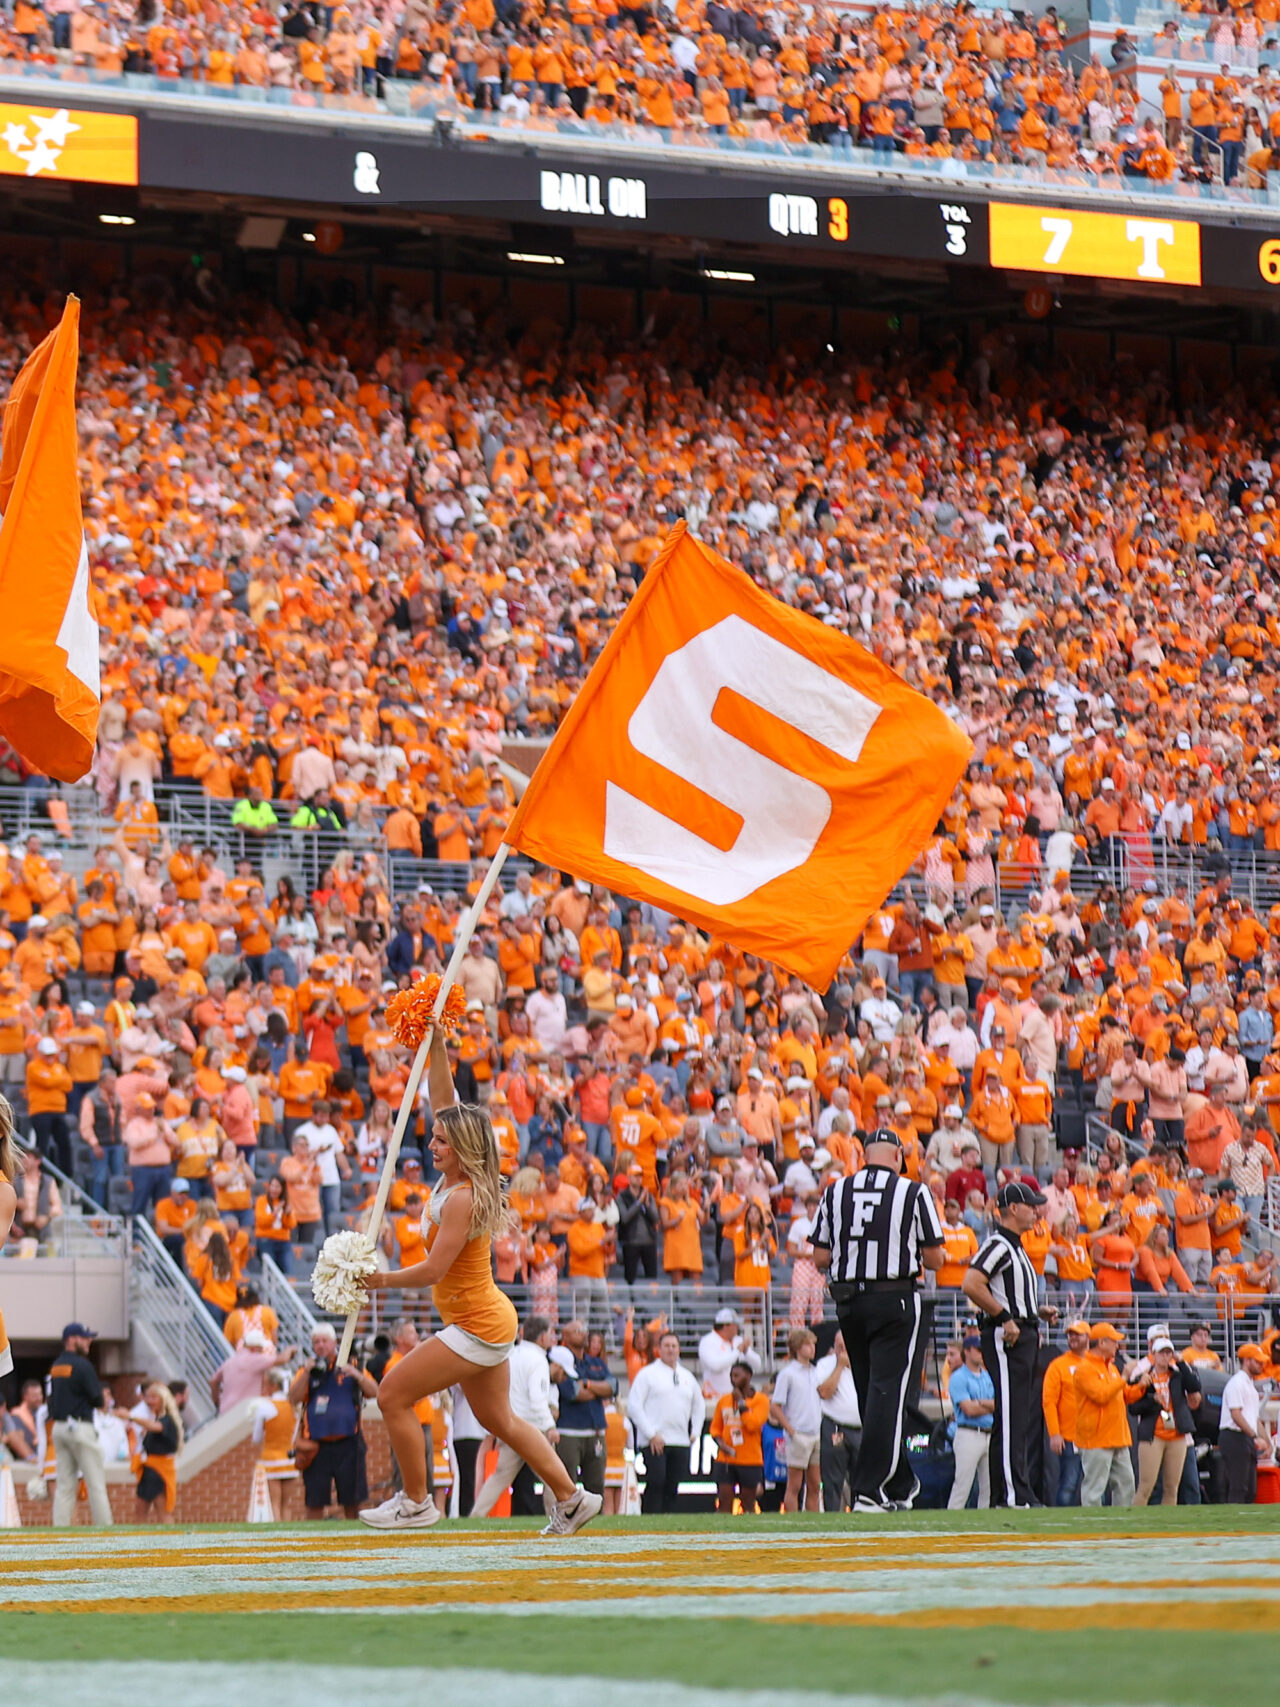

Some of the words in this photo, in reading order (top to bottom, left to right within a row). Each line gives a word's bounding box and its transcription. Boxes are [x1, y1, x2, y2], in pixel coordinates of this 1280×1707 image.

[353, 151, 381, 194] &
[540, 170, 605, 215] BALL
[608, 177, 647, 219] ON
[769, 193, 818, 236] QTR
[828, 198, 849, 241] 3
[939, 204, 971, 224] TOL
[945, 224, 967, 256] 3
[1041, 217, 1073, 264] 7
[1126, 219, 1174, 278] T
[603, 613, 883, 906] S
[850, 1192, 882, 1237] F
